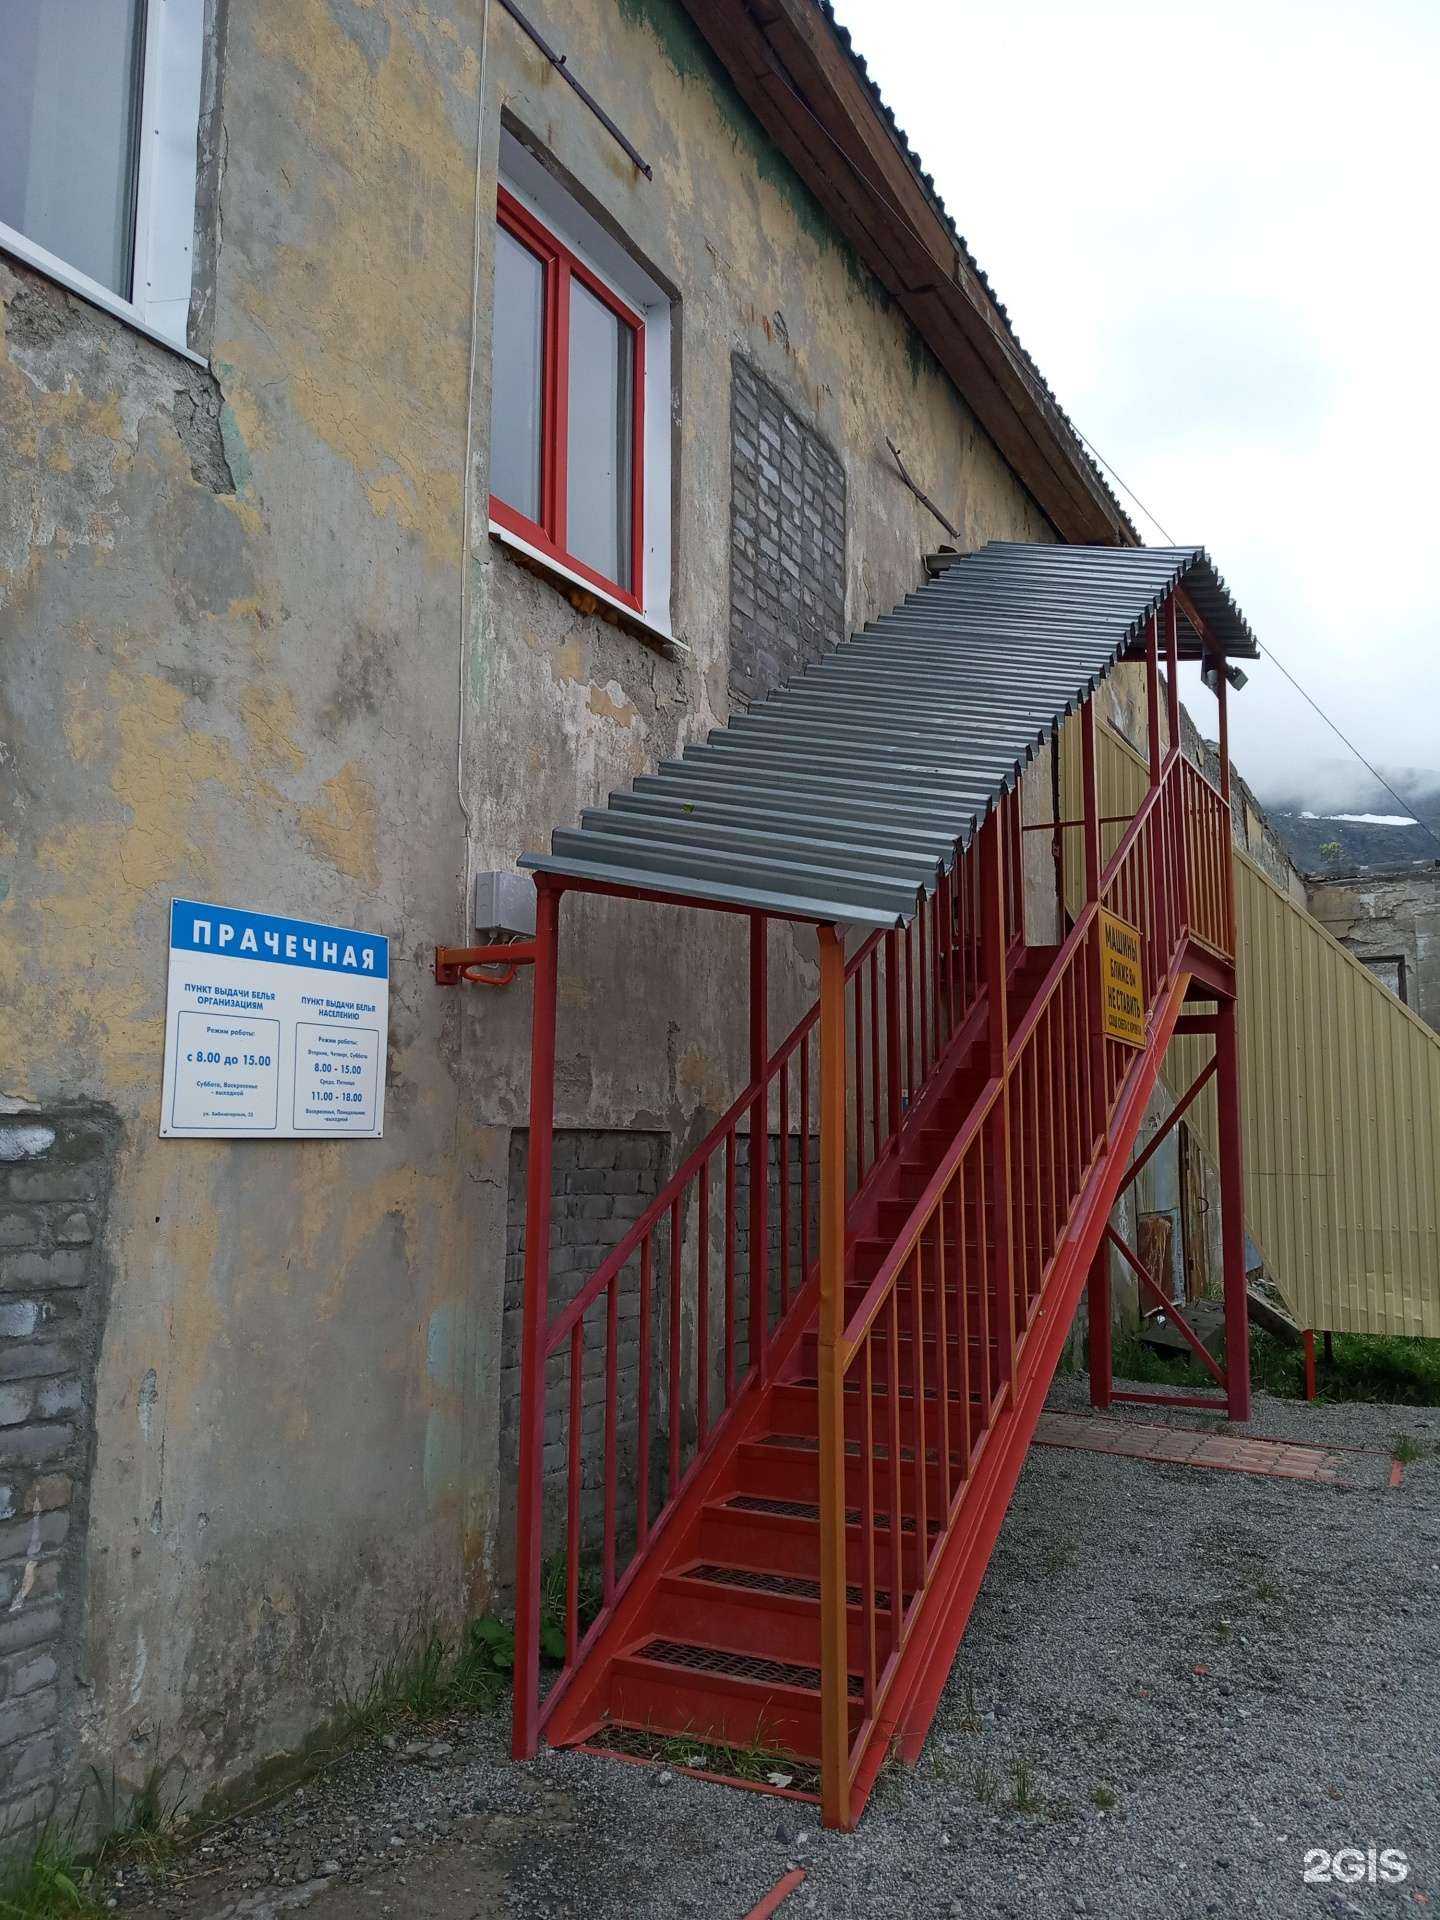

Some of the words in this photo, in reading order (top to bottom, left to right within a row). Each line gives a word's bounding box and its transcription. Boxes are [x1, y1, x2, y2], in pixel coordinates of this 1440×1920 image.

[192, 919, 375, 970] ПРАЧЕЧНАЯ
[1105, 922, 1137, 963] МАШИНЫ
[1110, 959, 1129, 984] БЛИЖЕ
[184, 983, 213, 994] ПУНКТ
[214, 986, 250, 998] ВЫДАЧИ
[251, 991, 276, 1001] БЕЛЬЯ
[197, 996, 264, 1010] ОРГАНИЗАЦИЯМ
[301, 996, 324, 1006] ПУНКТ
[325, 999, 354, 1009] ВЫДАЧИ
[355, 1003, 376, 1012] БЕЛЬЯ
[1117, 990, 1140, 1018] СТАВИТЬ
[318, 1009, 360, 1020] НАСЕЛЕНИЮ
[206, 1026, 229, 1034] Режим
[196, 1051, 220, 1064] 8.00
[223, 1056, 238, 1066] до
[243, 1055, 271, 1066] 15.00
[314, 1063, 332, 1073] 8.00
[341, 1065, 362, 1074] 15.00
[312, 1091, 333, 1101] 11.00
[342, 1092, 363, 1102] 18.00
